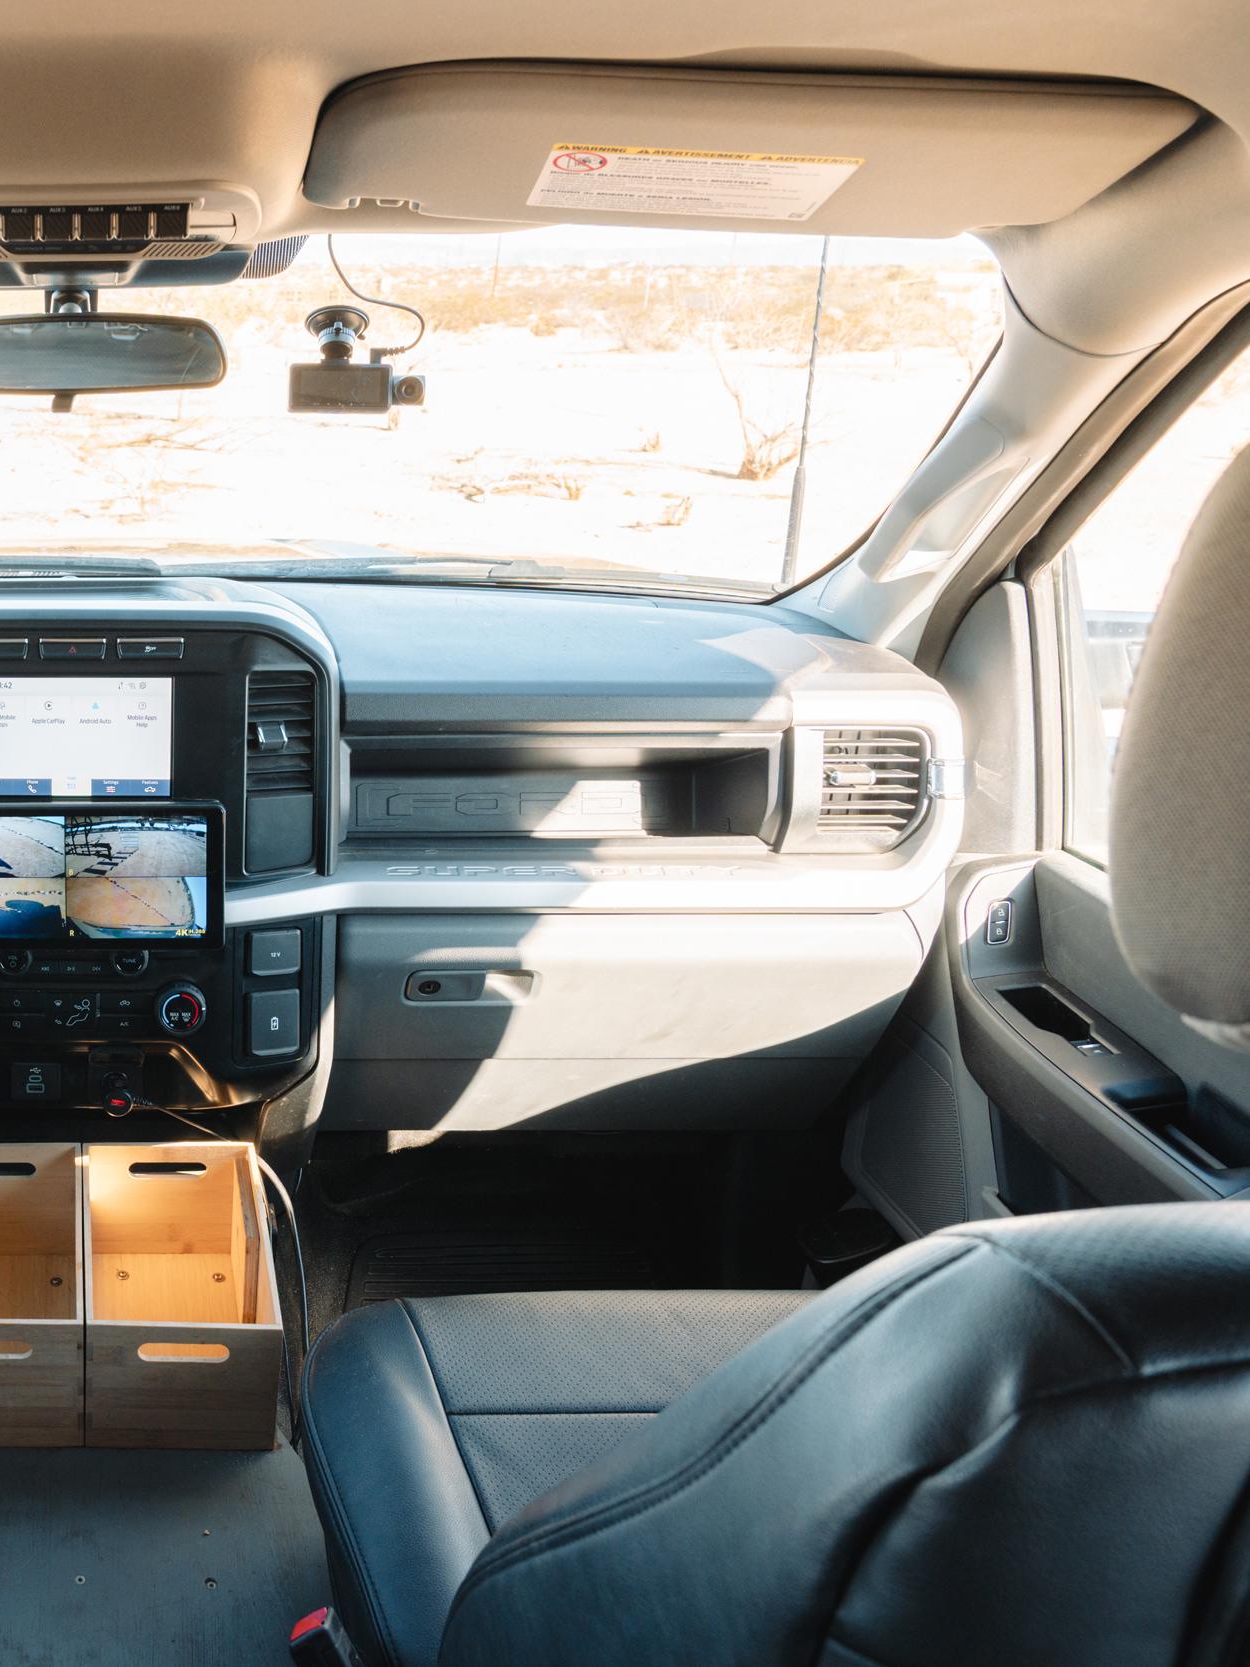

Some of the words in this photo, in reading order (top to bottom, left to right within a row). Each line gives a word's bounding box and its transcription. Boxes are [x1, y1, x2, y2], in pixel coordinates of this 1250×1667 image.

[572, 145, 627, 153] WARNING
[652, 150, 750, 160] AVERTISSEMENT
[776, 156, 860, 165] ADVERTENCIA
[386, 865, 578, 877] SUPER
[590, 865, 743, 877] DUTY
